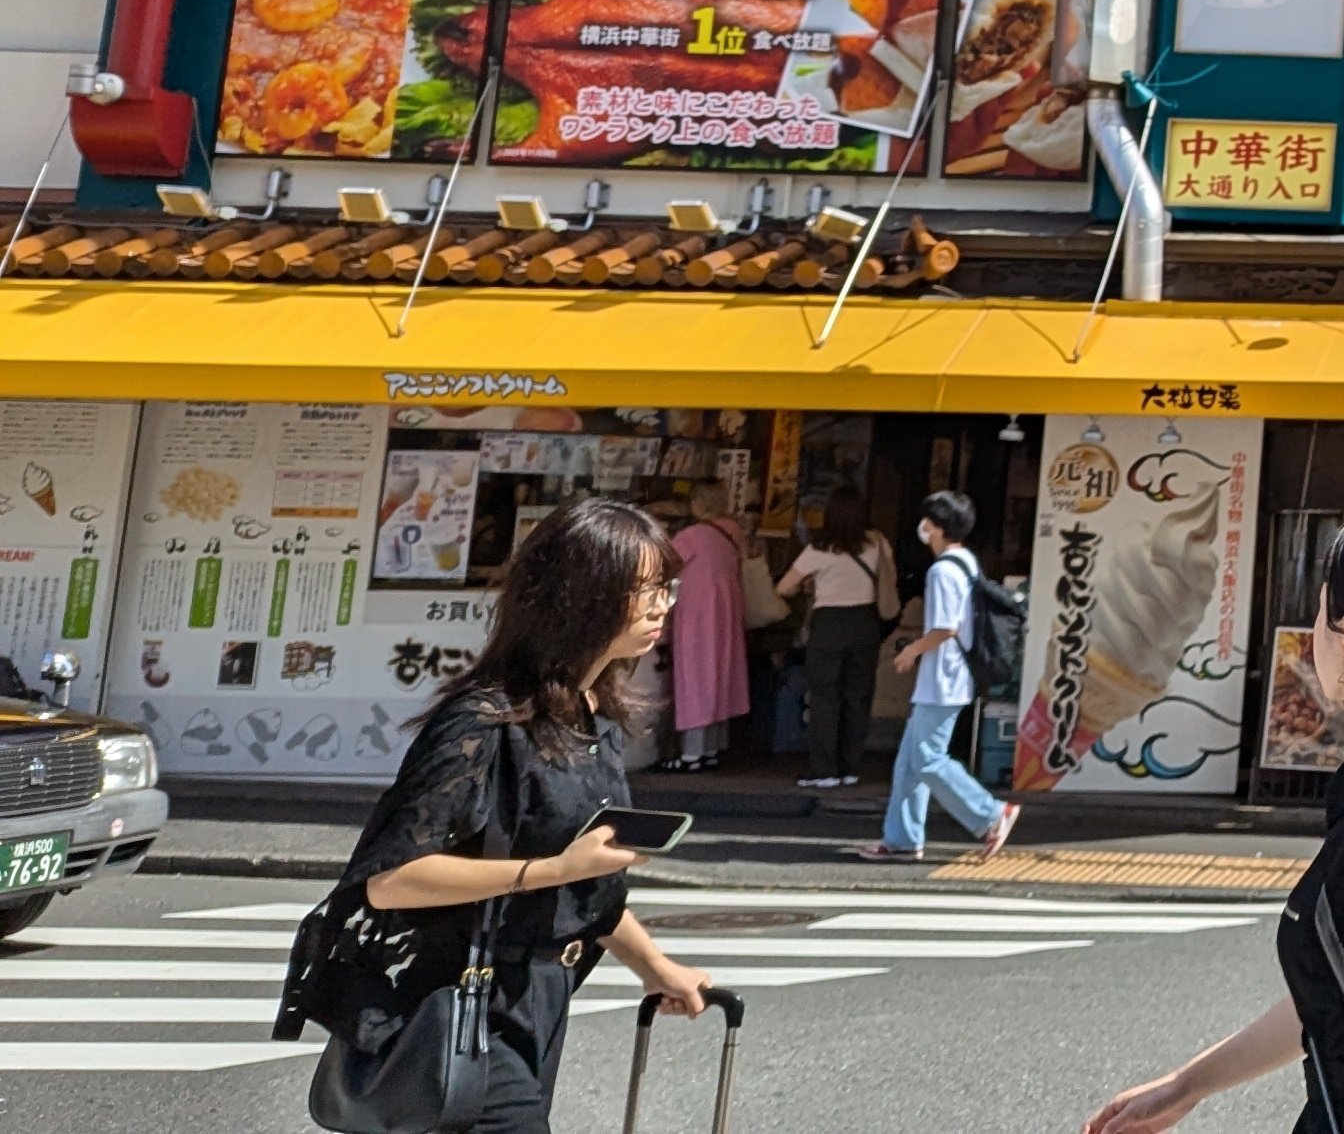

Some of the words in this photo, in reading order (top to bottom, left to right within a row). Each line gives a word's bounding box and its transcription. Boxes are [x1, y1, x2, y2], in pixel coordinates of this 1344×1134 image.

[686, 6, 747, 55] 1位
[752, 30, 832, 52] 食べ放題
[577, 86, 821, 119] 素材と味にこだわった
[559, 114, 841, 148] ワンランク上の食べ放題
[1180, 129, 1327, 174] 中華街
[1175, 172, 1322, 200] 大通り入口
[1048, 521, 1100, 770] 杏仁ソフトクリーム
